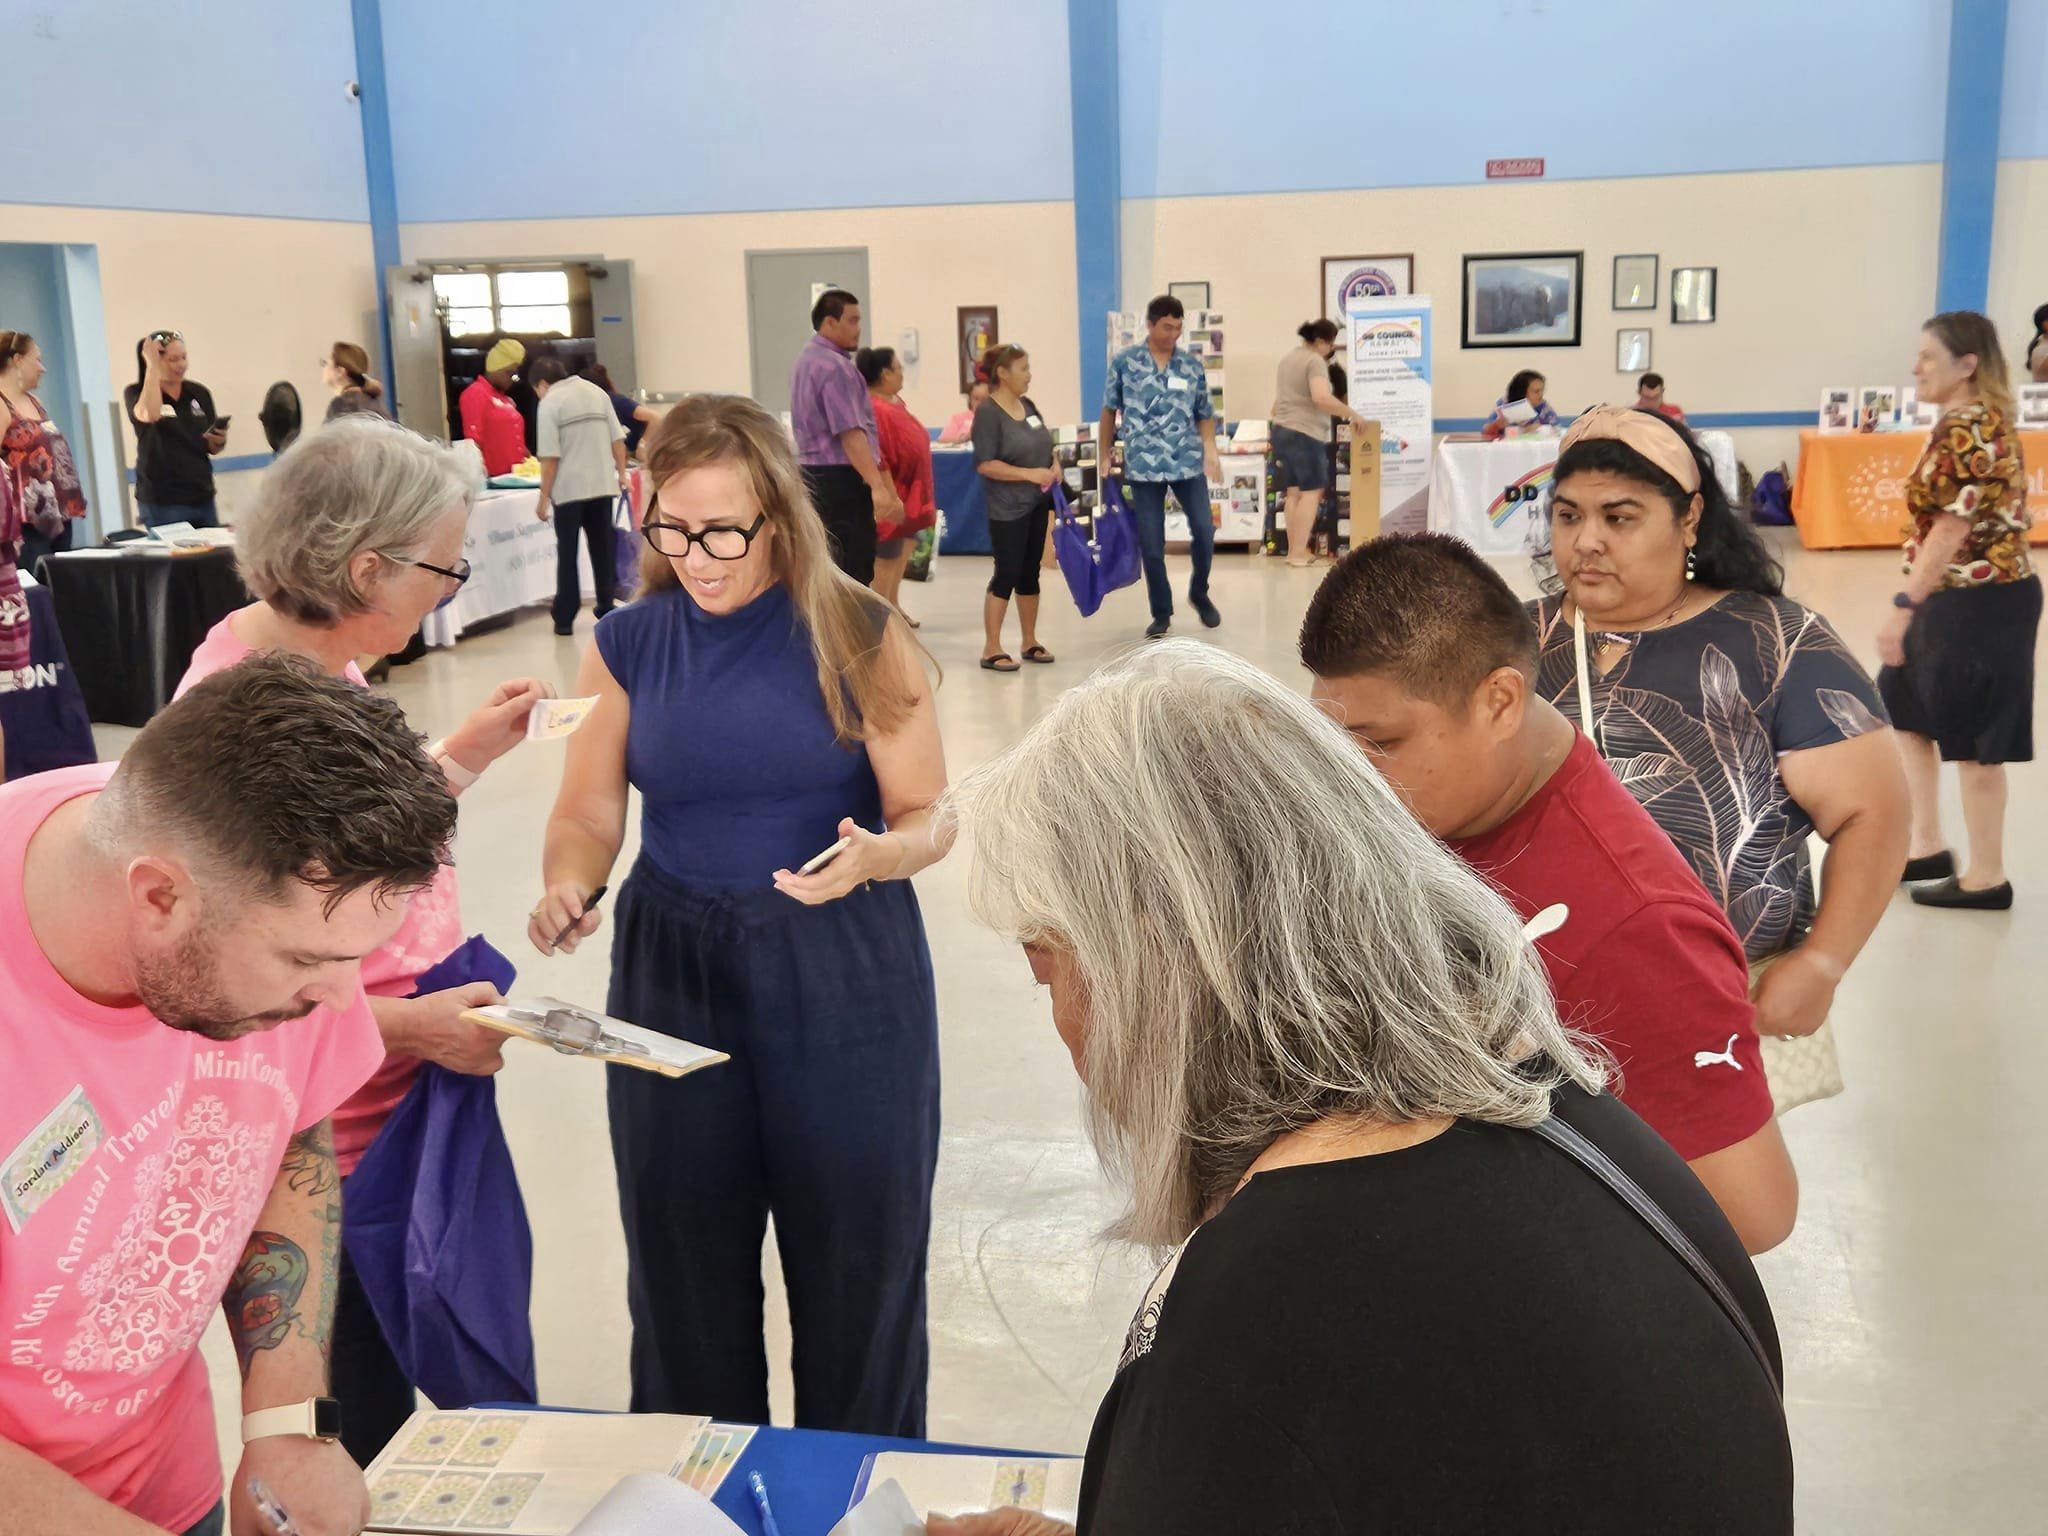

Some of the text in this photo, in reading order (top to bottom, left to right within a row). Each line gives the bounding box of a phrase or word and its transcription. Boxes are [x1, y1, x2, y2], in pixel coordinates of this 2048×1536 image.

[1505, 485, 1538, 503] DD
[15, 1119, 90, 1197] Jordan Addison
[57, 1164, 111, 1273] Annual
[115, 1388, 148, 1416] of
